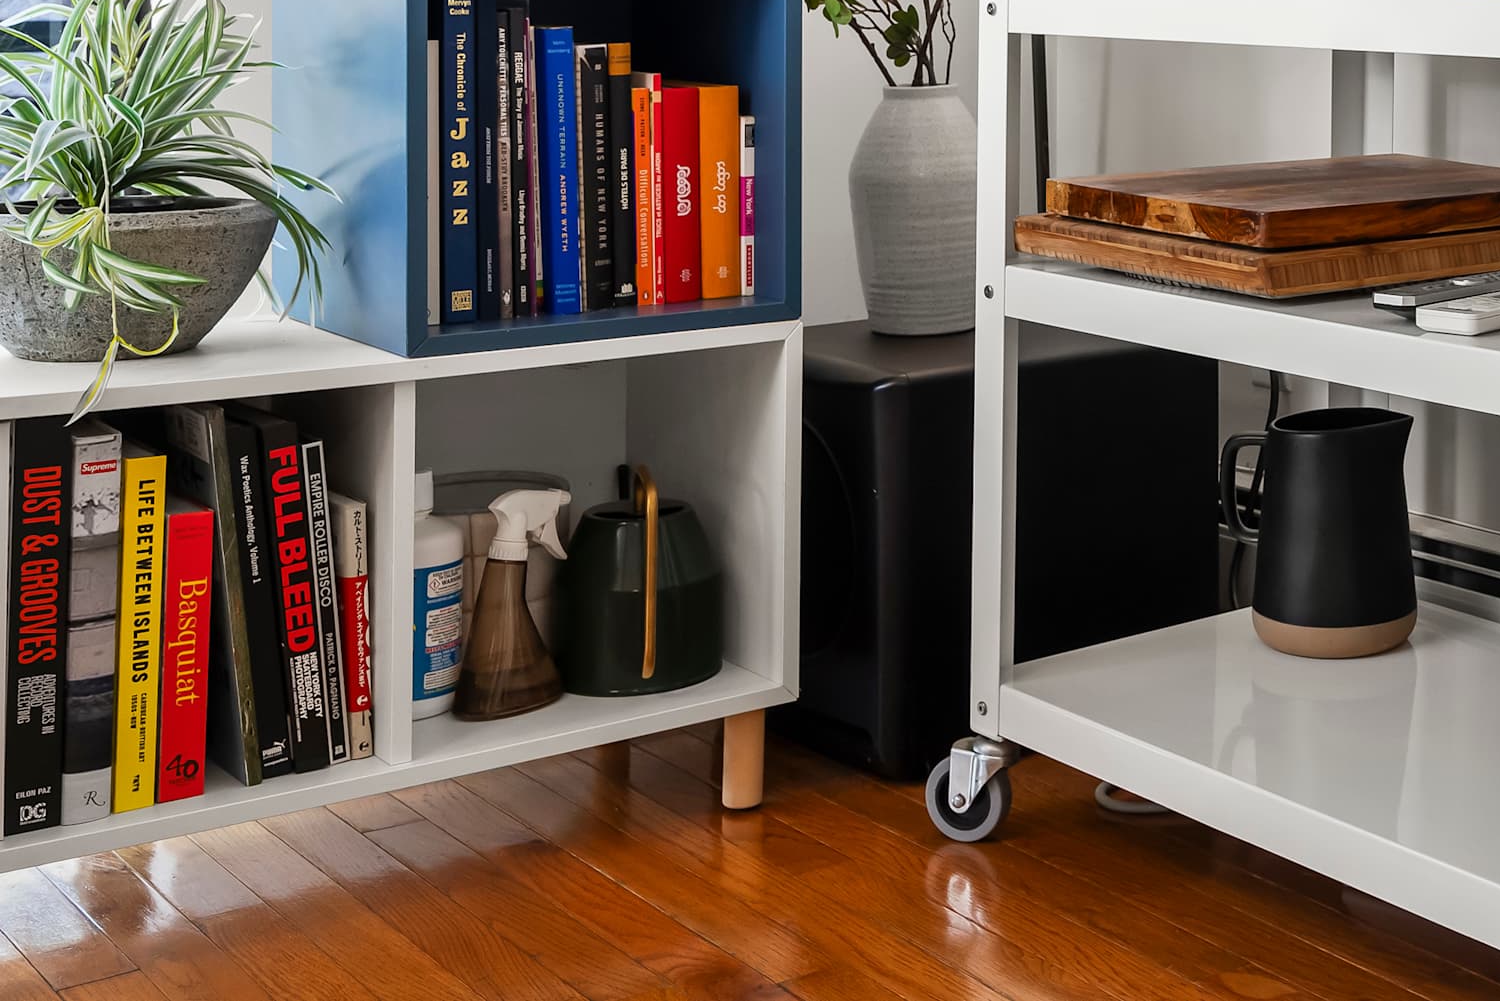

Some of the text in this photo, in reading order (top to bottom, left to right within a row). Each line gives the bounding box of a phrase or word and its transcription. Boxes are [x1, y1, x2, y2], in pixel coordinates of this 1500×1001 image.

[456, 32, 466, 50] The
[456, 52, 466, 98] Chronicle
[513, 51, 523, 84] REGGAE
[456, 101, 466, 111] of
[498, 84, 507, 121] PERSONAL
[514, 97, 523, 112] Story
[593, 112, 605, 161] HUMANS
[556, 72, 568, 252] UNKNOWN TERRAIN ANDREW WYETH
[595, 167, 606, 181] OF
[619, 147, 628, 169] PARIS
[619, 169, 628, 180] DE
[596, 187, 607, 213] NEW
[638, 169, 650, 268] Difficult Conversations
[597, 217, 608, 249] YORK
[82, 462, 117, 473] Supreme
[239, 455, 249, 474] Wax
[241, 474, 253, 504] Poetics
[310, 472, 323, 518] EMPIRE
[244, 504, 258, 546] Anthology,
[313, 518, 328, 566] ROLLER
[18, 464, 62, 664] DUST & GROOVES
[248, 546, 261, 576] Volume
[270, 445, 315, 653] FULL BLEED
[130, 478, 156, 683] LIFE BETWEEN ISLANDS
[318, 566, 332, 607] DISCO
[167, 576, 208, 706] Basquiat
[325, 631, 336, 665] PATRICK
[15, 677, 31, 724] COLLECTING
[28, 675, 44, 708] RECORD
[292, 655, 308, 720] PHOTOGRAPHY
[300, 653, 315, 711] SKATEBOARD
[308, 651, 323, 718] NEW YORK CITY
[328, 676, 340, 720] PAGNANO
[40, 673, 56, 735] ADVENTURES IN
[165, 753, 200, 779] 40
[15, 786, 52, 800] EILON PAZ
